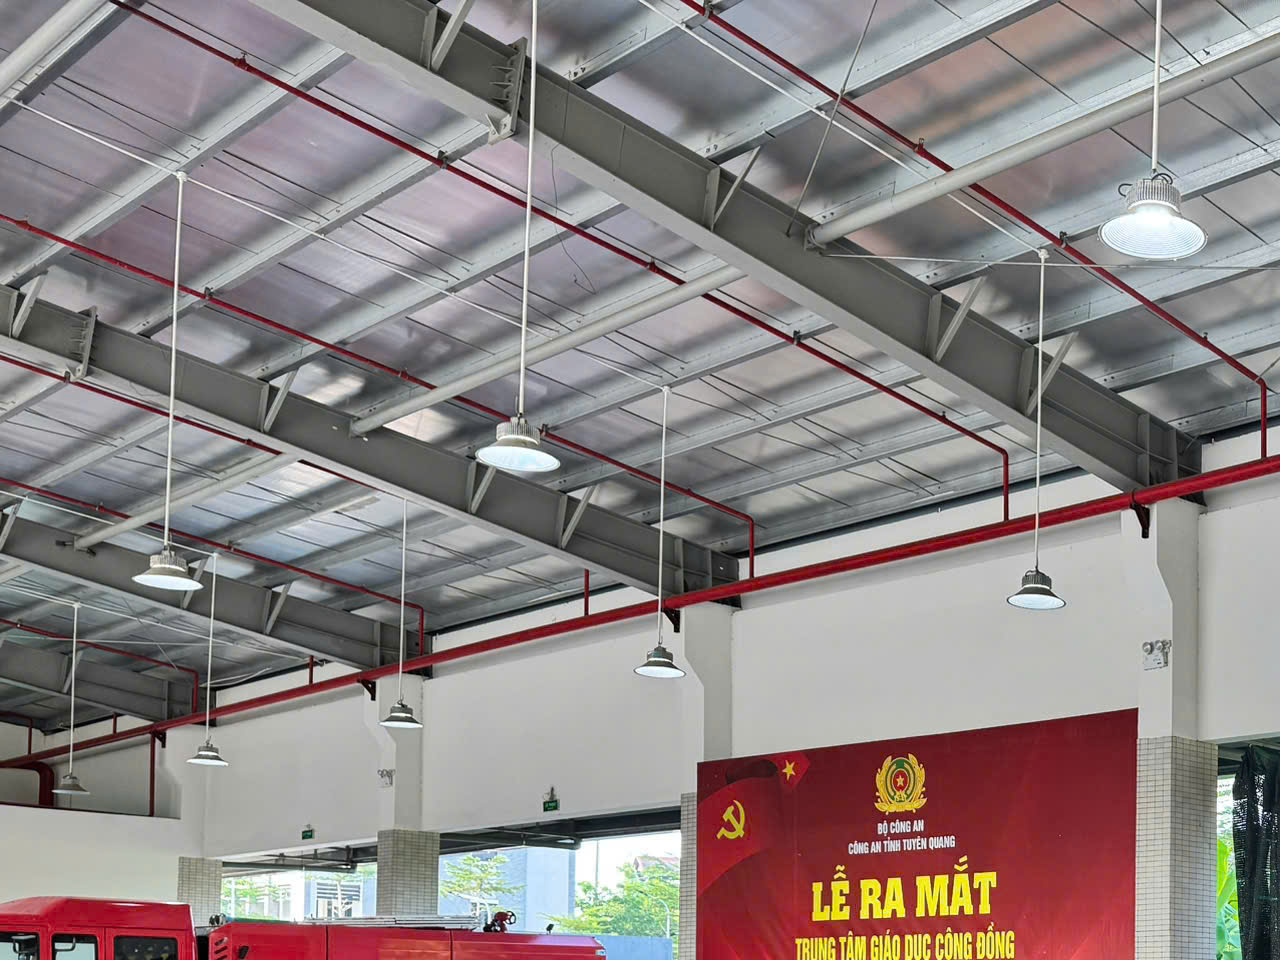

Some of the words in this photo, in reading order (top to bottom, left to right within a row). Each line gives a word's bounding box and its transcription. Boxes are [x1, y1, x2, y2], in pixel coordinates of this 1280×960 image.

[877, 820, 888, 836] BỘ
[890, 819, 911, 834] CÔNG
[913, 819, 924, 832] AN
[848, 840, 869, 854] CÔNG
[870, 840, 881, 853] AN
[883, 837, 900, 852] TỈNH
[902, 836, 927, 851] TUYÊN
[928, 835, 956, 850] QUANG
[812, 865, 850, 921] LỄ
[859, 877, 906, 920] RA
[915, 855, 997, 917] MẮT
[976, 921, 1015, 960] ĐỒNG
